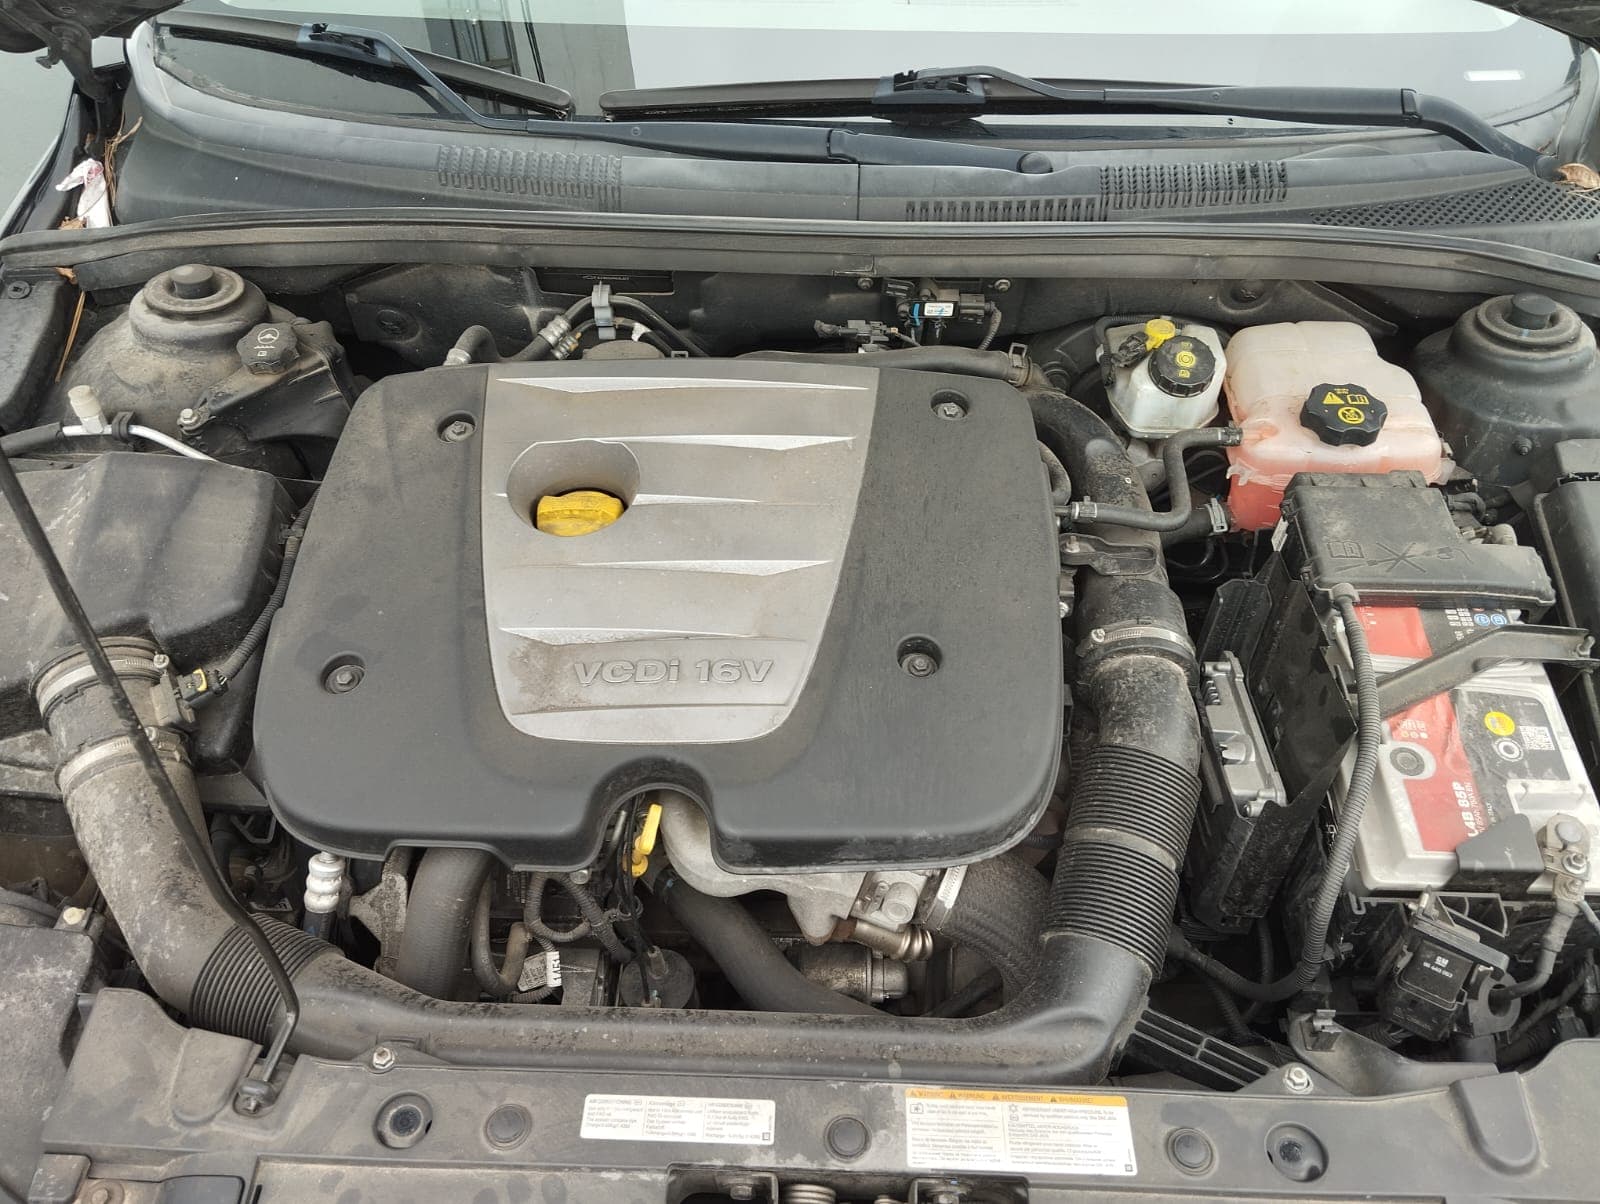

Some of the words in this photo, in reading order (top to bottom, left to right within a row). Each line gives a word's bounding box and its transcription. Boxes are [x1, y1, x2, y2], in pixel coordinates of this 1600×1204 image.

[573, 658, 681, 688] VCDi
[694, 658, 774, 684] 16V
[1451, 780, 1470, 808] 85P
